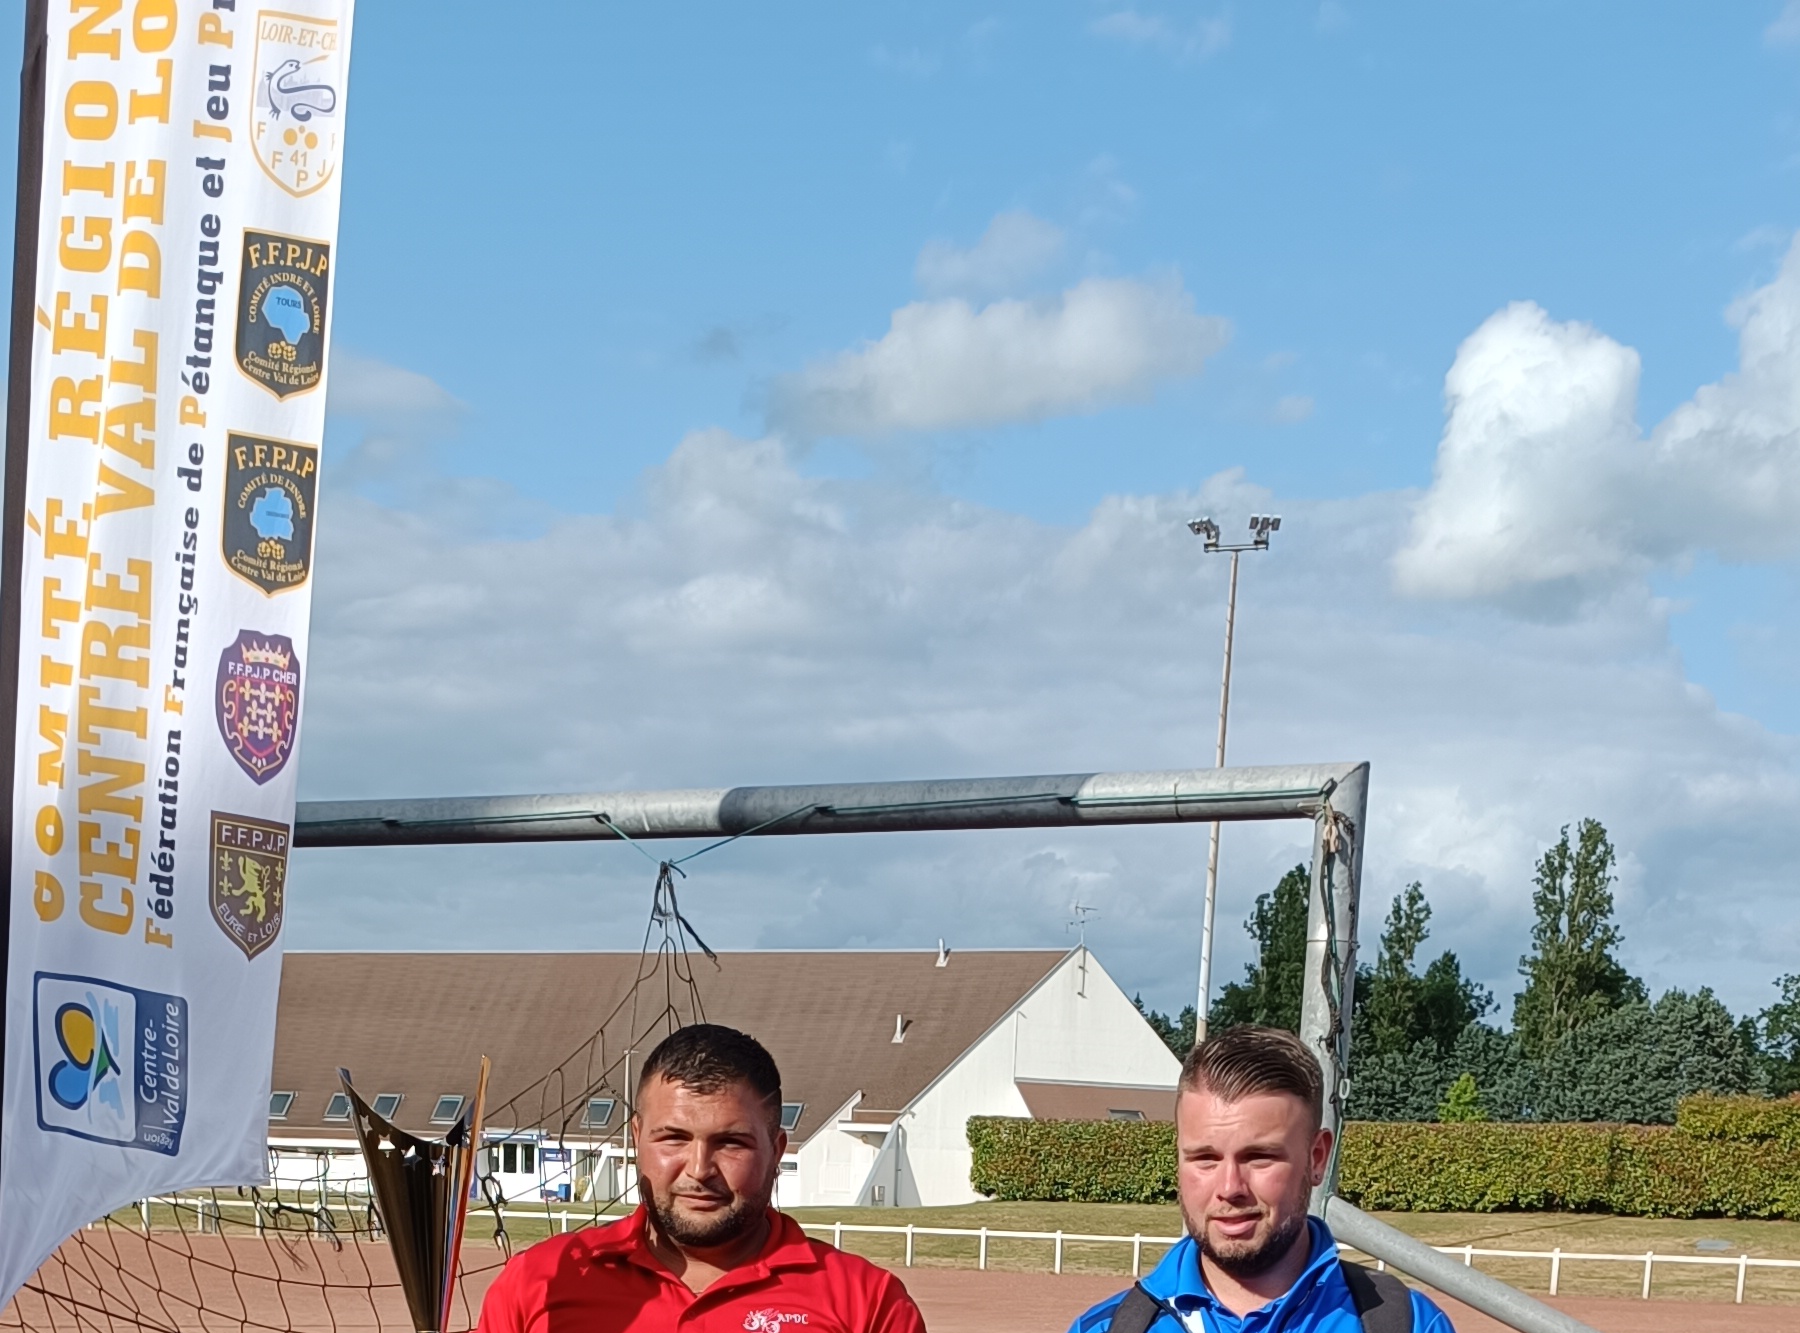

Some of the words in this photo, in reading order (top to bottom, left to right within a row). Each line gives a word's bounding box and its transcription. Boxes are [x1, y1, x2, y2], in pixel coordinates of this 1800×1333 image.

[192, 63, 232, 143] Jeu
[195, 156, 226, 198] et
[290, 150, 308, 168] 41
[116, 159, 167, 299] DE
[248, 242, 328, 278] F.F.P.J.P
[270, 272, 302, 287] INDRE
[179, 213, 224, 429] Pétanque
[93, 328, 159, 521] VAL
[176, 442, 205, 492] de
[234, 444, 315, 479] F.F.P.J.P
[163, 506, 200, 717] Française
[272, 671, 297, 686] CHER
[26, 497, 93, 922] COMITÉ
[79, 552, 153, 935] CENTRE
[145, 729, 182, 949] Fédération
[221, 824, 286, 853] F.F.P.J.P
[218, 902, 246, 937] EURE
[139, 1018, 158, 1104] Centre-
[161, 1002, 180, 1061] Loire
